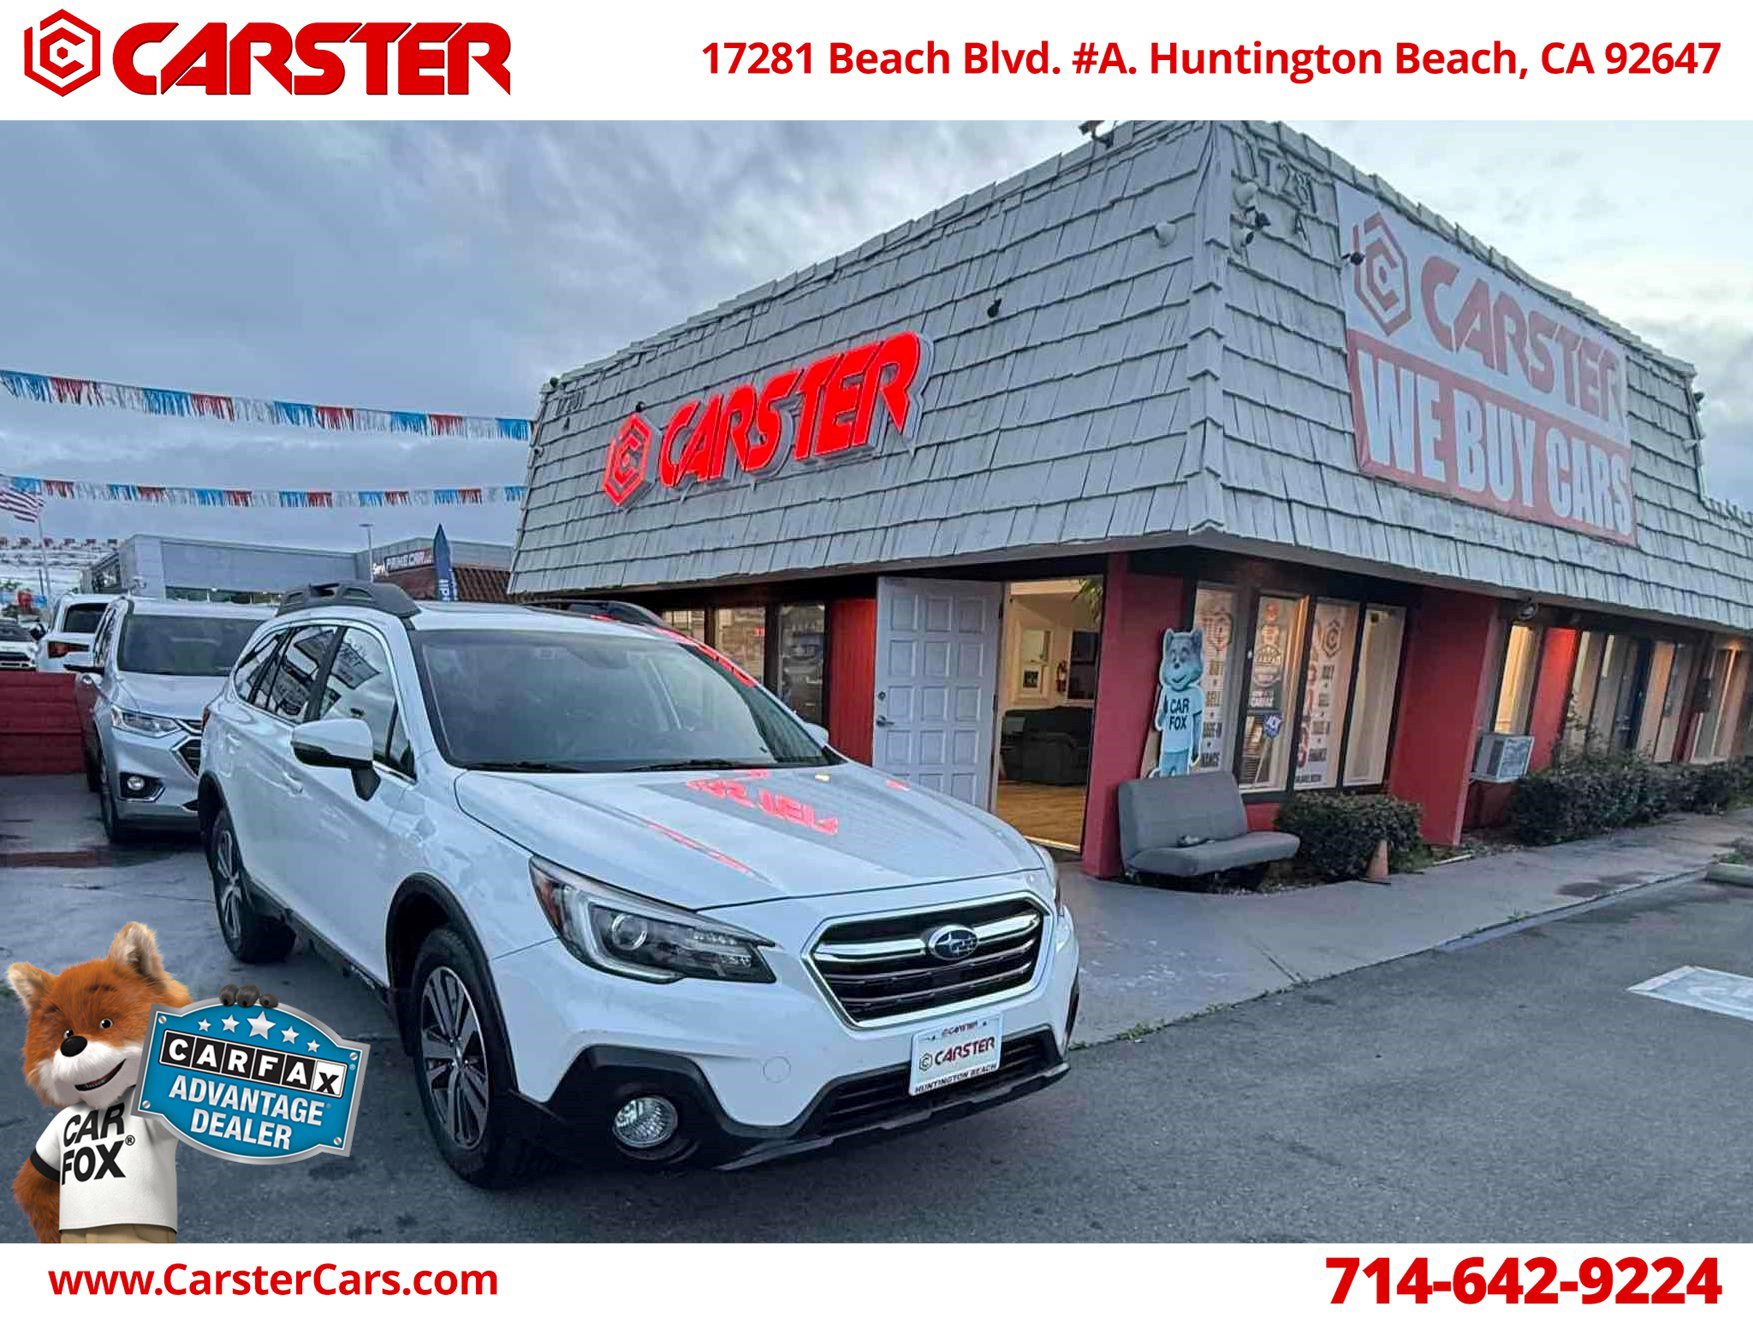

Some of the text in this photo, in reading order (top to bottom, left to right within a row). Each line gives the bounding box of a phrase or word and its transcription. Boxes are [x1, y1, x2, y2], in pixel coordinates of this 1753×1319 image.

[1421, 256, 1625, 427] CARSTER
[658, 331, 922, 488] CARSTER
[1357, 350, 1633, 538] WE BUY CARS
[1169, 697, 1190, 714] CAR
[1168, 714, 1188, 732] FOX
[935, 1036, 995, 1065] CARSTER
[915, 1063, 997, 1092] HUNTINGTON BEACH
